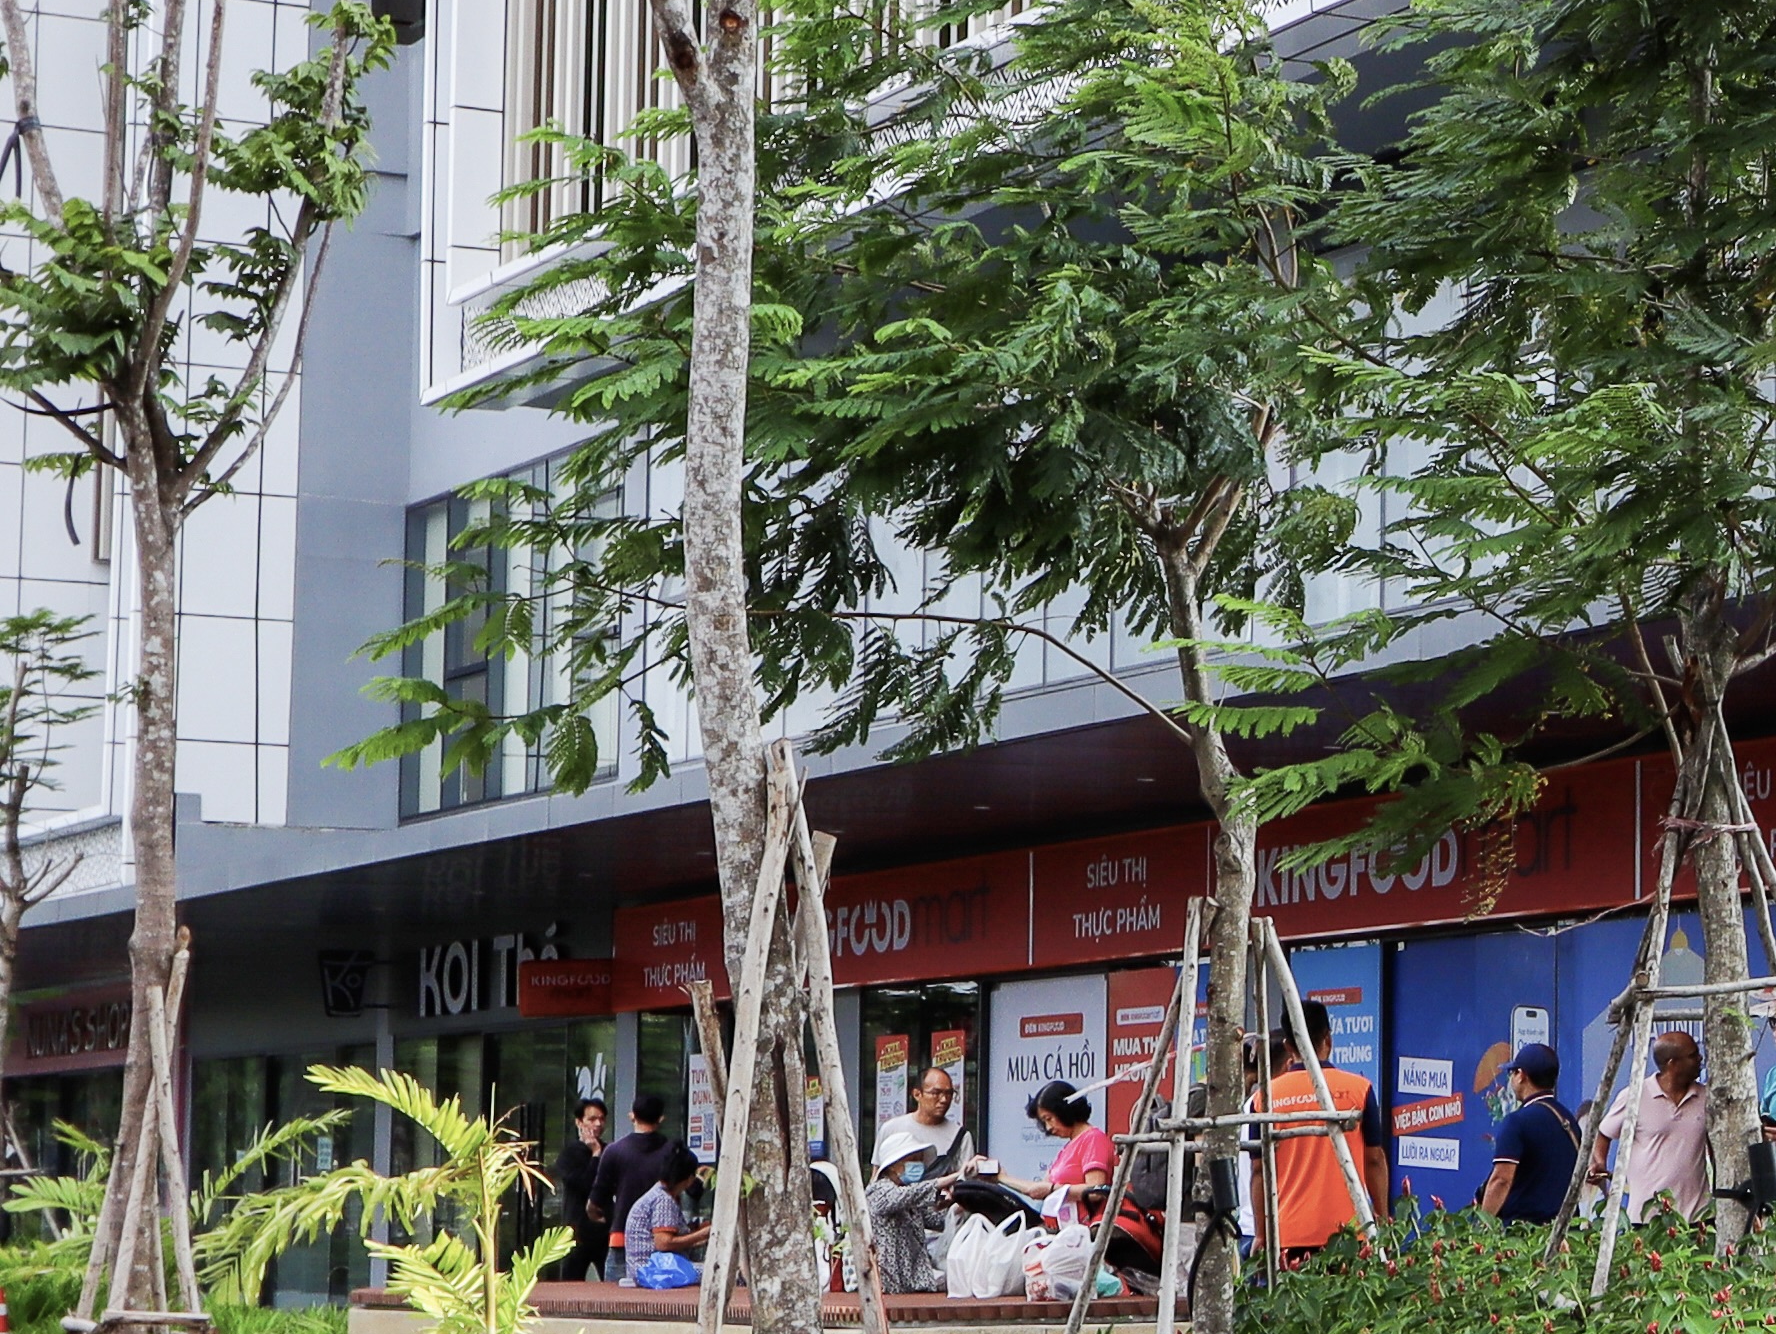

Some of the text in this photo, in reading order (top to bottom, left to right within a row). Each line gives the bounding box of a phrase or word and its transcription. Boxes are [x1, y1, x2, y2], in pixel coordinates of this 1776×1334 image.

[1087, 853, 1147, 889] SIÊU THỊ
[1072, 894, 1161, 944] THỰC PHẨM
[419, 940, 479, 1019] KOI
[1007, 1039, 1095, 1082] MUA CÁ HỒI
[1113, 1038, 1141, 1056] MUA
[1403, 1063, 1427, 1087] NẮNG
